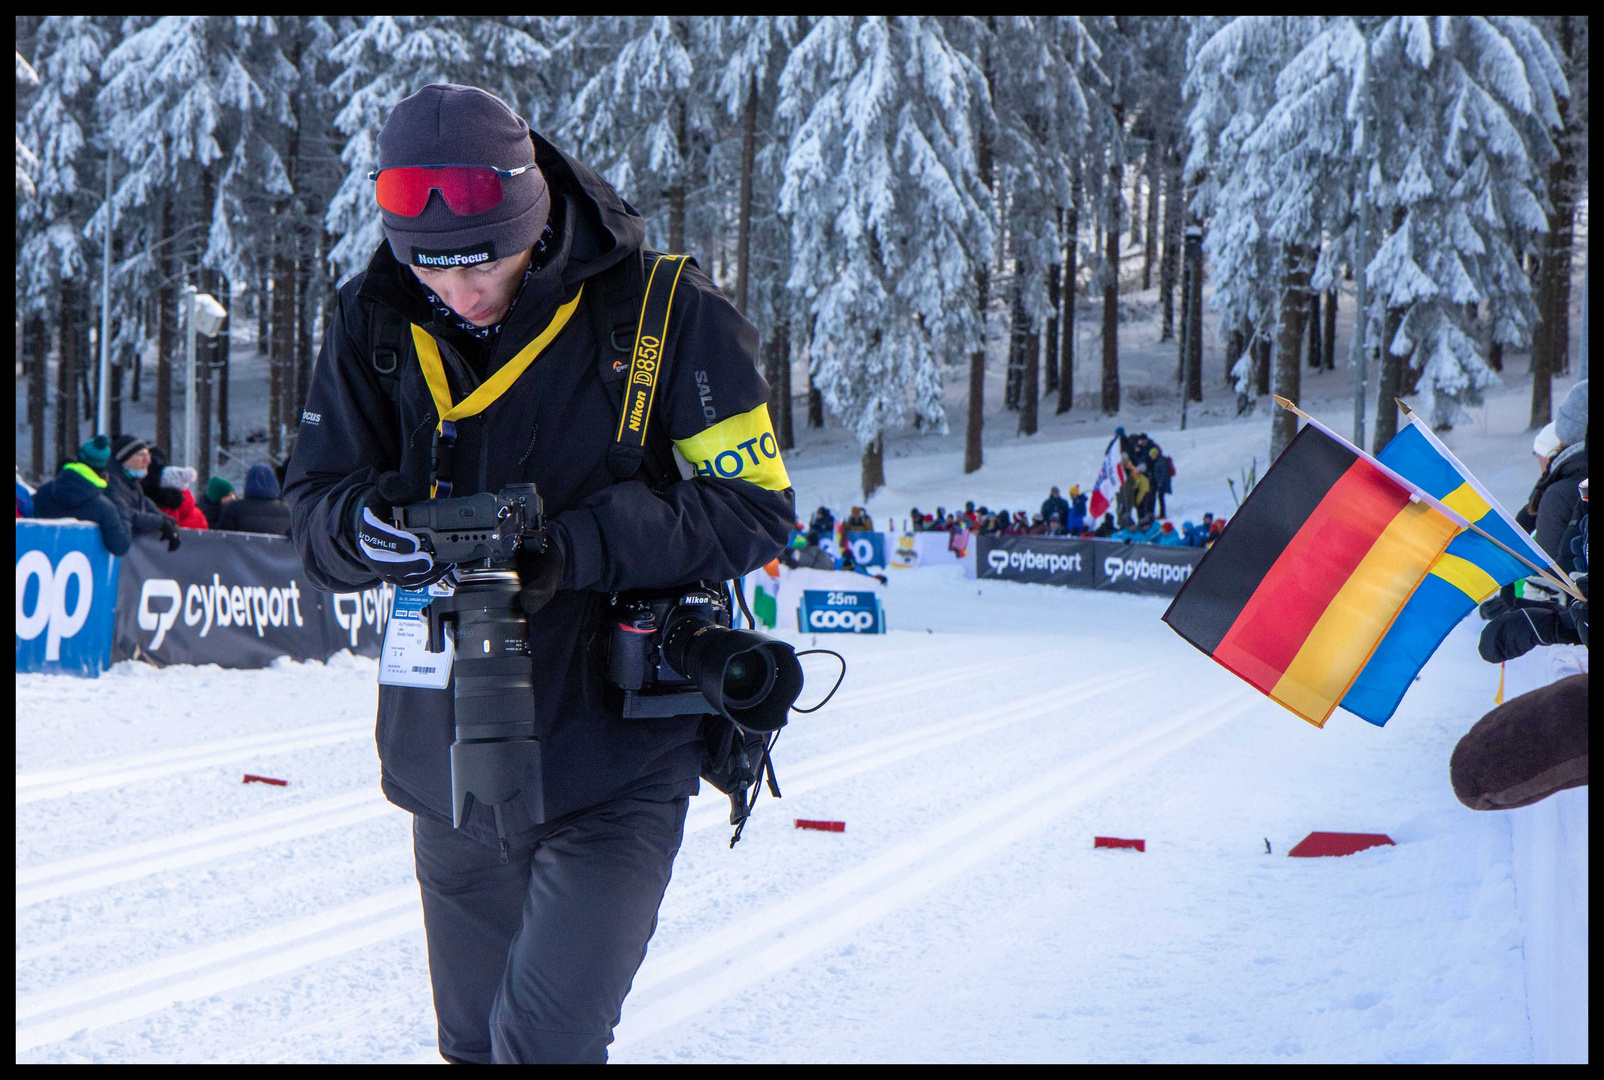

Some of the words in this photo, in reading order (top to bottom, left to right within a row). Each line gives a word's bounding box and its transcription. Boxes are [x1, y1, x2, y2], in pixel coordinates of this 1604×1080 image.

[418, 252, 489, 266] NordicFocus
[633, 335, 660, 387] D850
[628, 390, 647, 432] Nikon
[1009, 549, 1082, 574] cyberport
[1123, 558, 1193, 584] cyberport
[184, 573, 303, 638] cyberport
[685, 596, 709, 604] Nikon
[827, 592, 858, 606] 25m
[810, 610, 874, 632] coop
